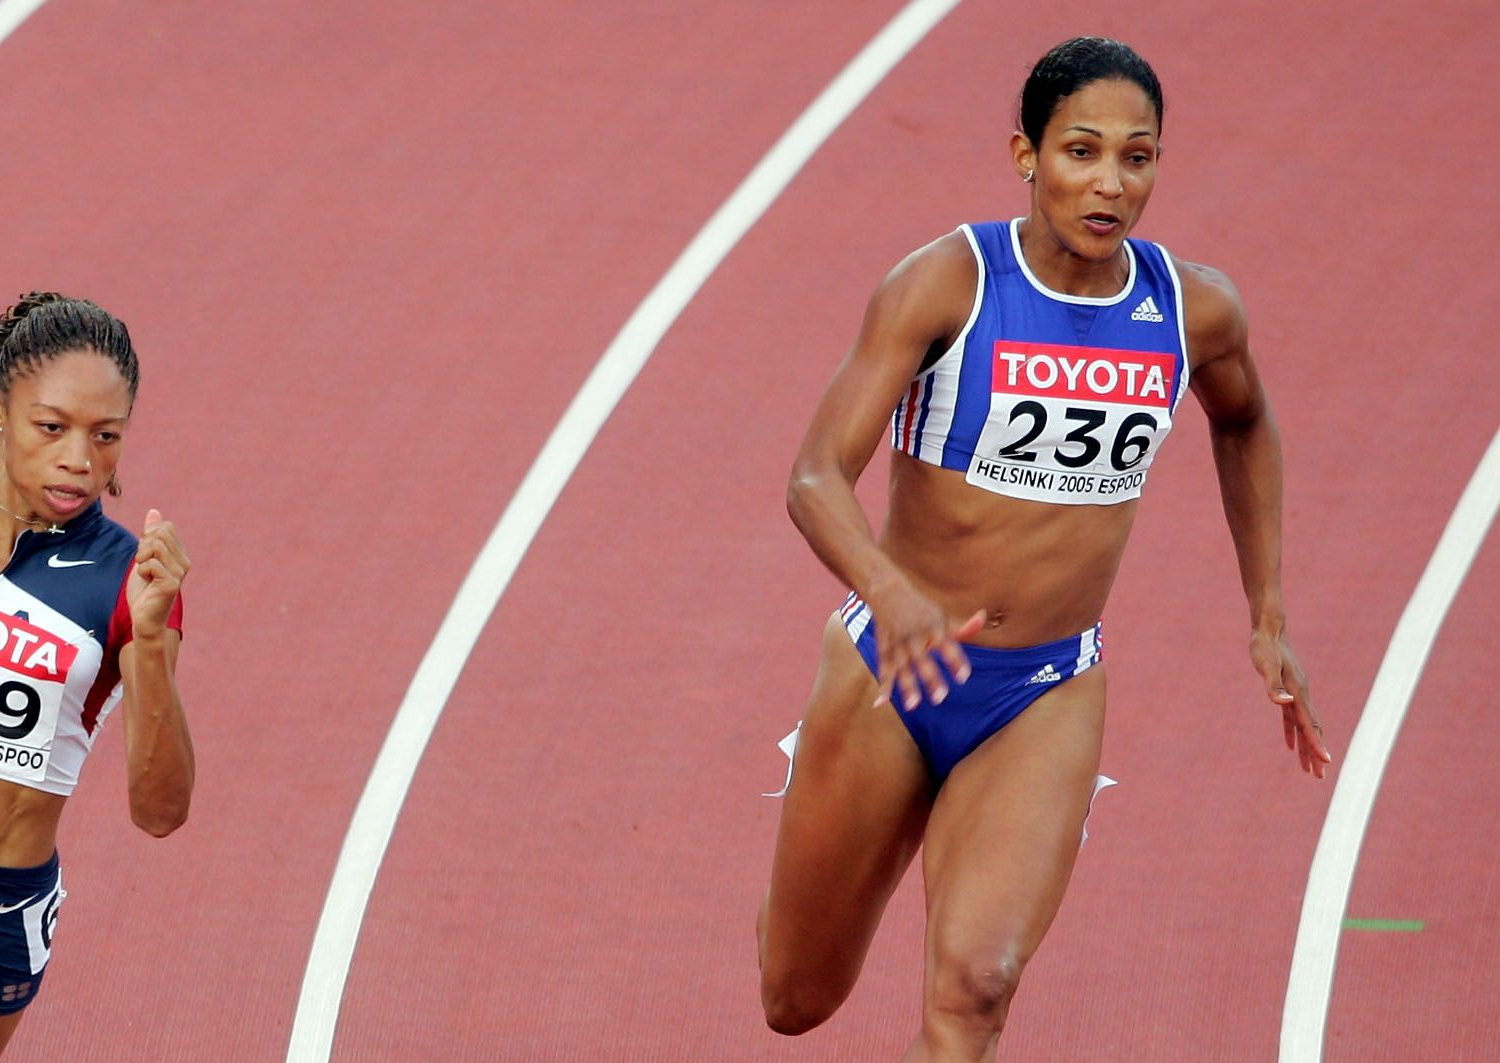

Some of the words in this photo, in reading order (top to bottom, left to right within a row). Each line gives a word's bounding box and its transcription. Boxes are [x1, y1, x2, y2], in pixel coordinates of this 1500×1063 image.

[1131, 311, 1163, 323] adidas
[999, 352, 1166, 399] TOYOTA
[998, 400, 1158, 471] 236
[976, 460, 1054, 490] HELSINKI
[1057, 475, 1095, 493] 2005
[1098, 472, 1143, 495] ESPOO
